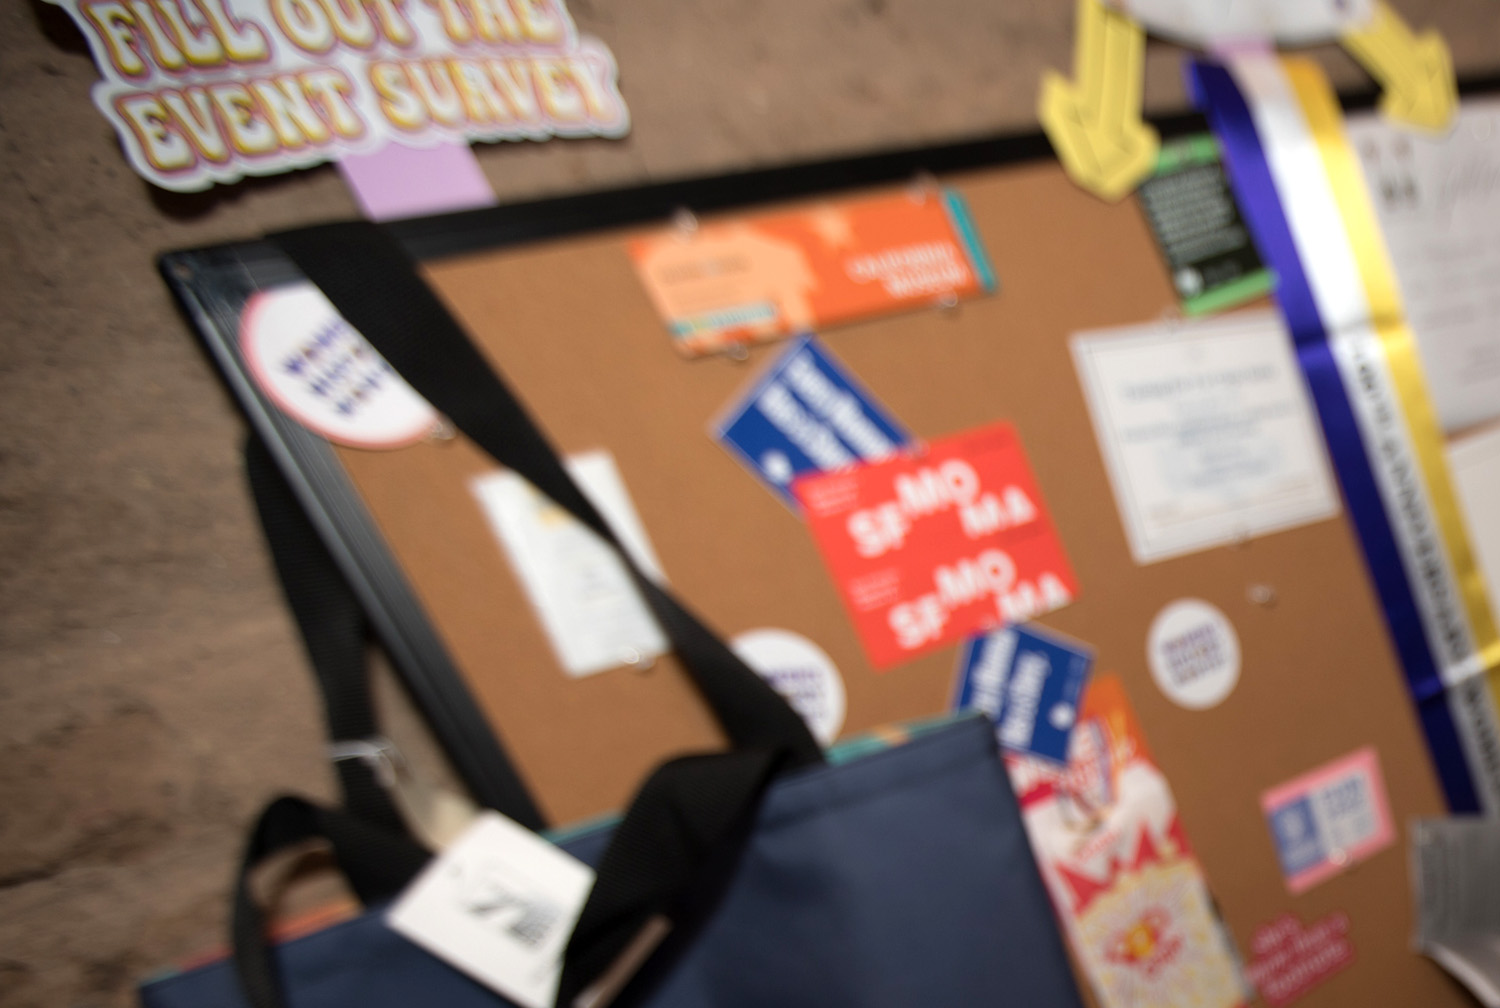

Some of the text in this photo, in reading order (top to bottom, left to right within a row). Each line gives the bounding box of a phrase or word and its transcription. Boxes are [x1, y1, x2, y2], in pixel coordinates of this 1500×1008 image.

[88, 0, 568, 79] FILL OUT THE
[115, 54, 625, 172] EVENT SURVEY
[846, 505, 911, 557] SF
[888, 598, 950, 649] SF
